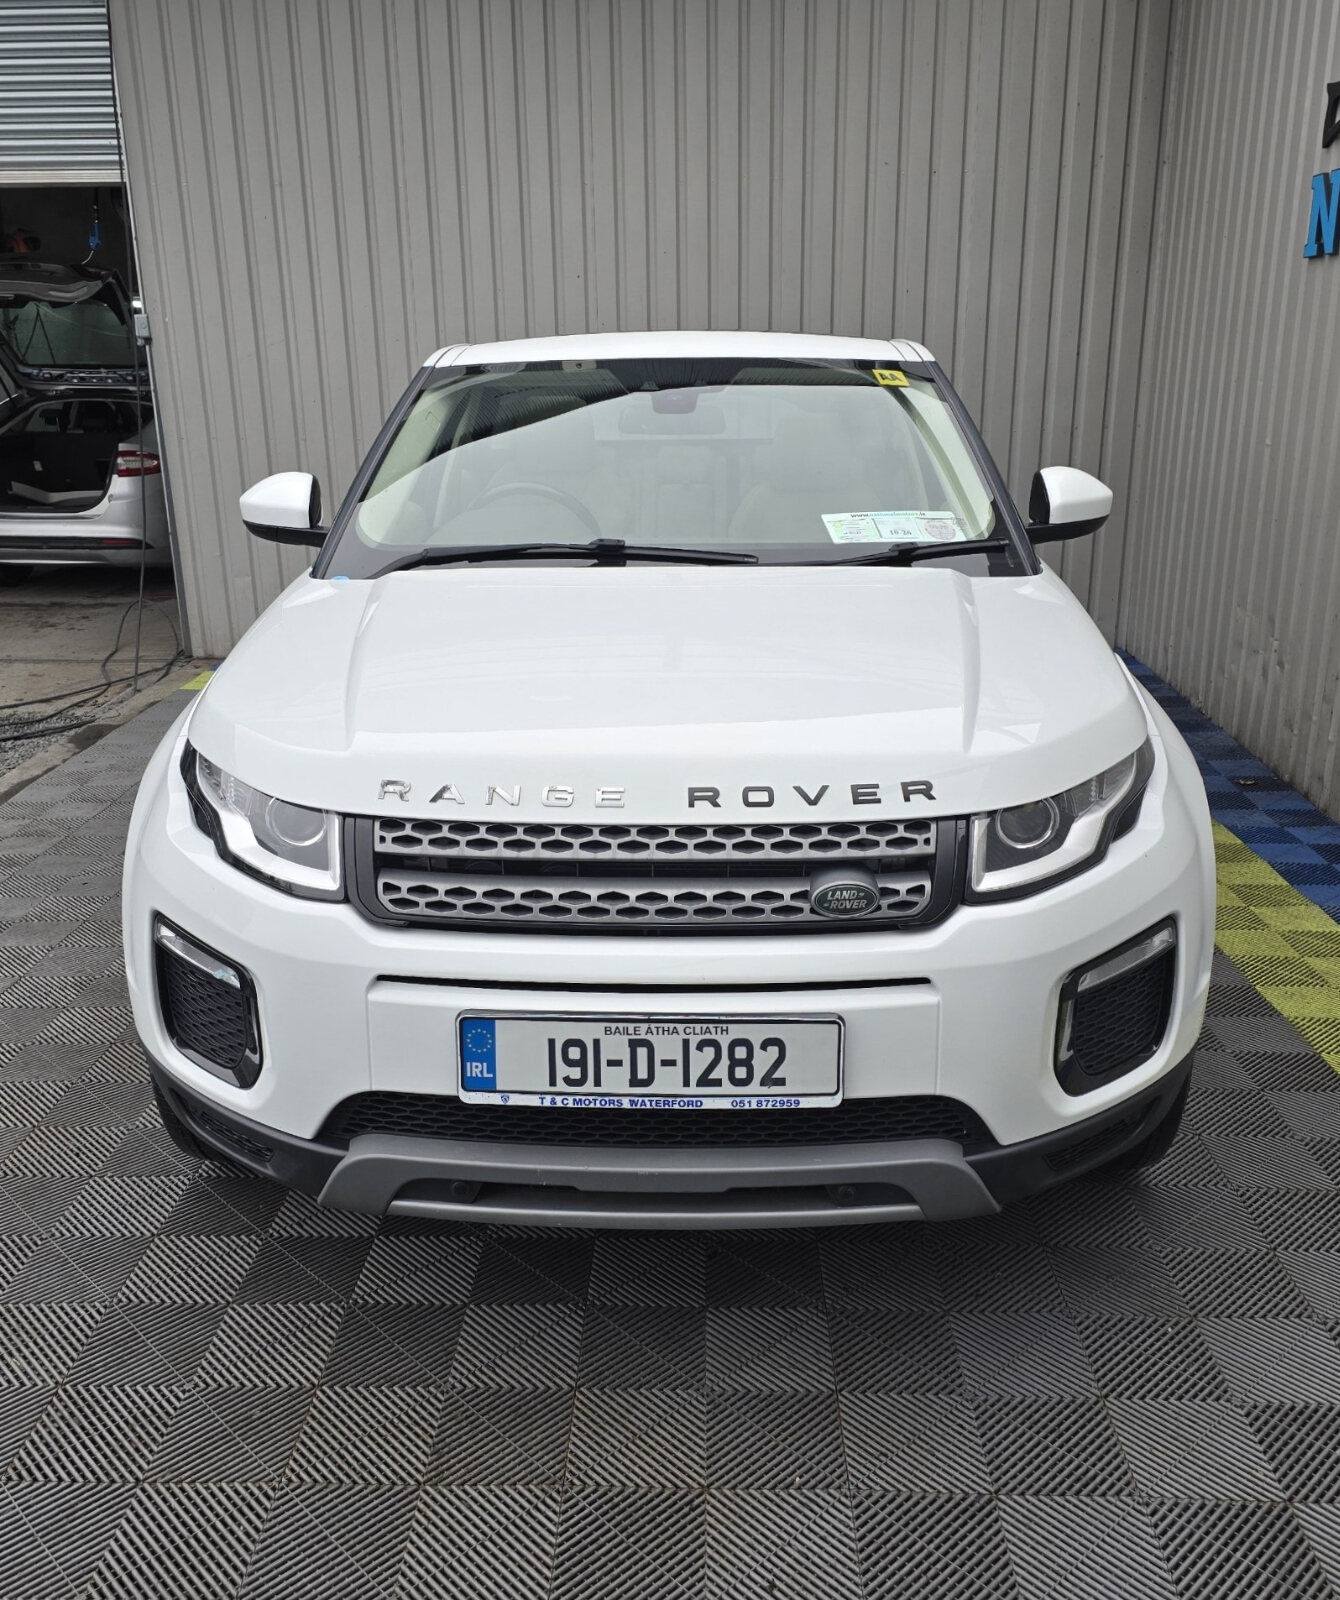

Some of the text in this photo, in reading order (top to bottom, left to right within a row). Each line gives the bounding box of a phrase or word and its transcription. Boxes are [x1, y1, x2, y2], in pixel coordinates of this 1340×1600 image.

[377, 779, 937, 808] RANGE ROVER
[827, 890, 858, 900] LAND
[830, 899, 867, 909] ROVER
[604, 1024, 729, 1036] BAILE ÁTHA CLIATH
[547, 1037, 788, 1089] 191-D-1282
[466, 1062, 494, 1078] IRL
[538, 1097, 800, 1108] T & C MOTORS WATERFORD 051 872959
